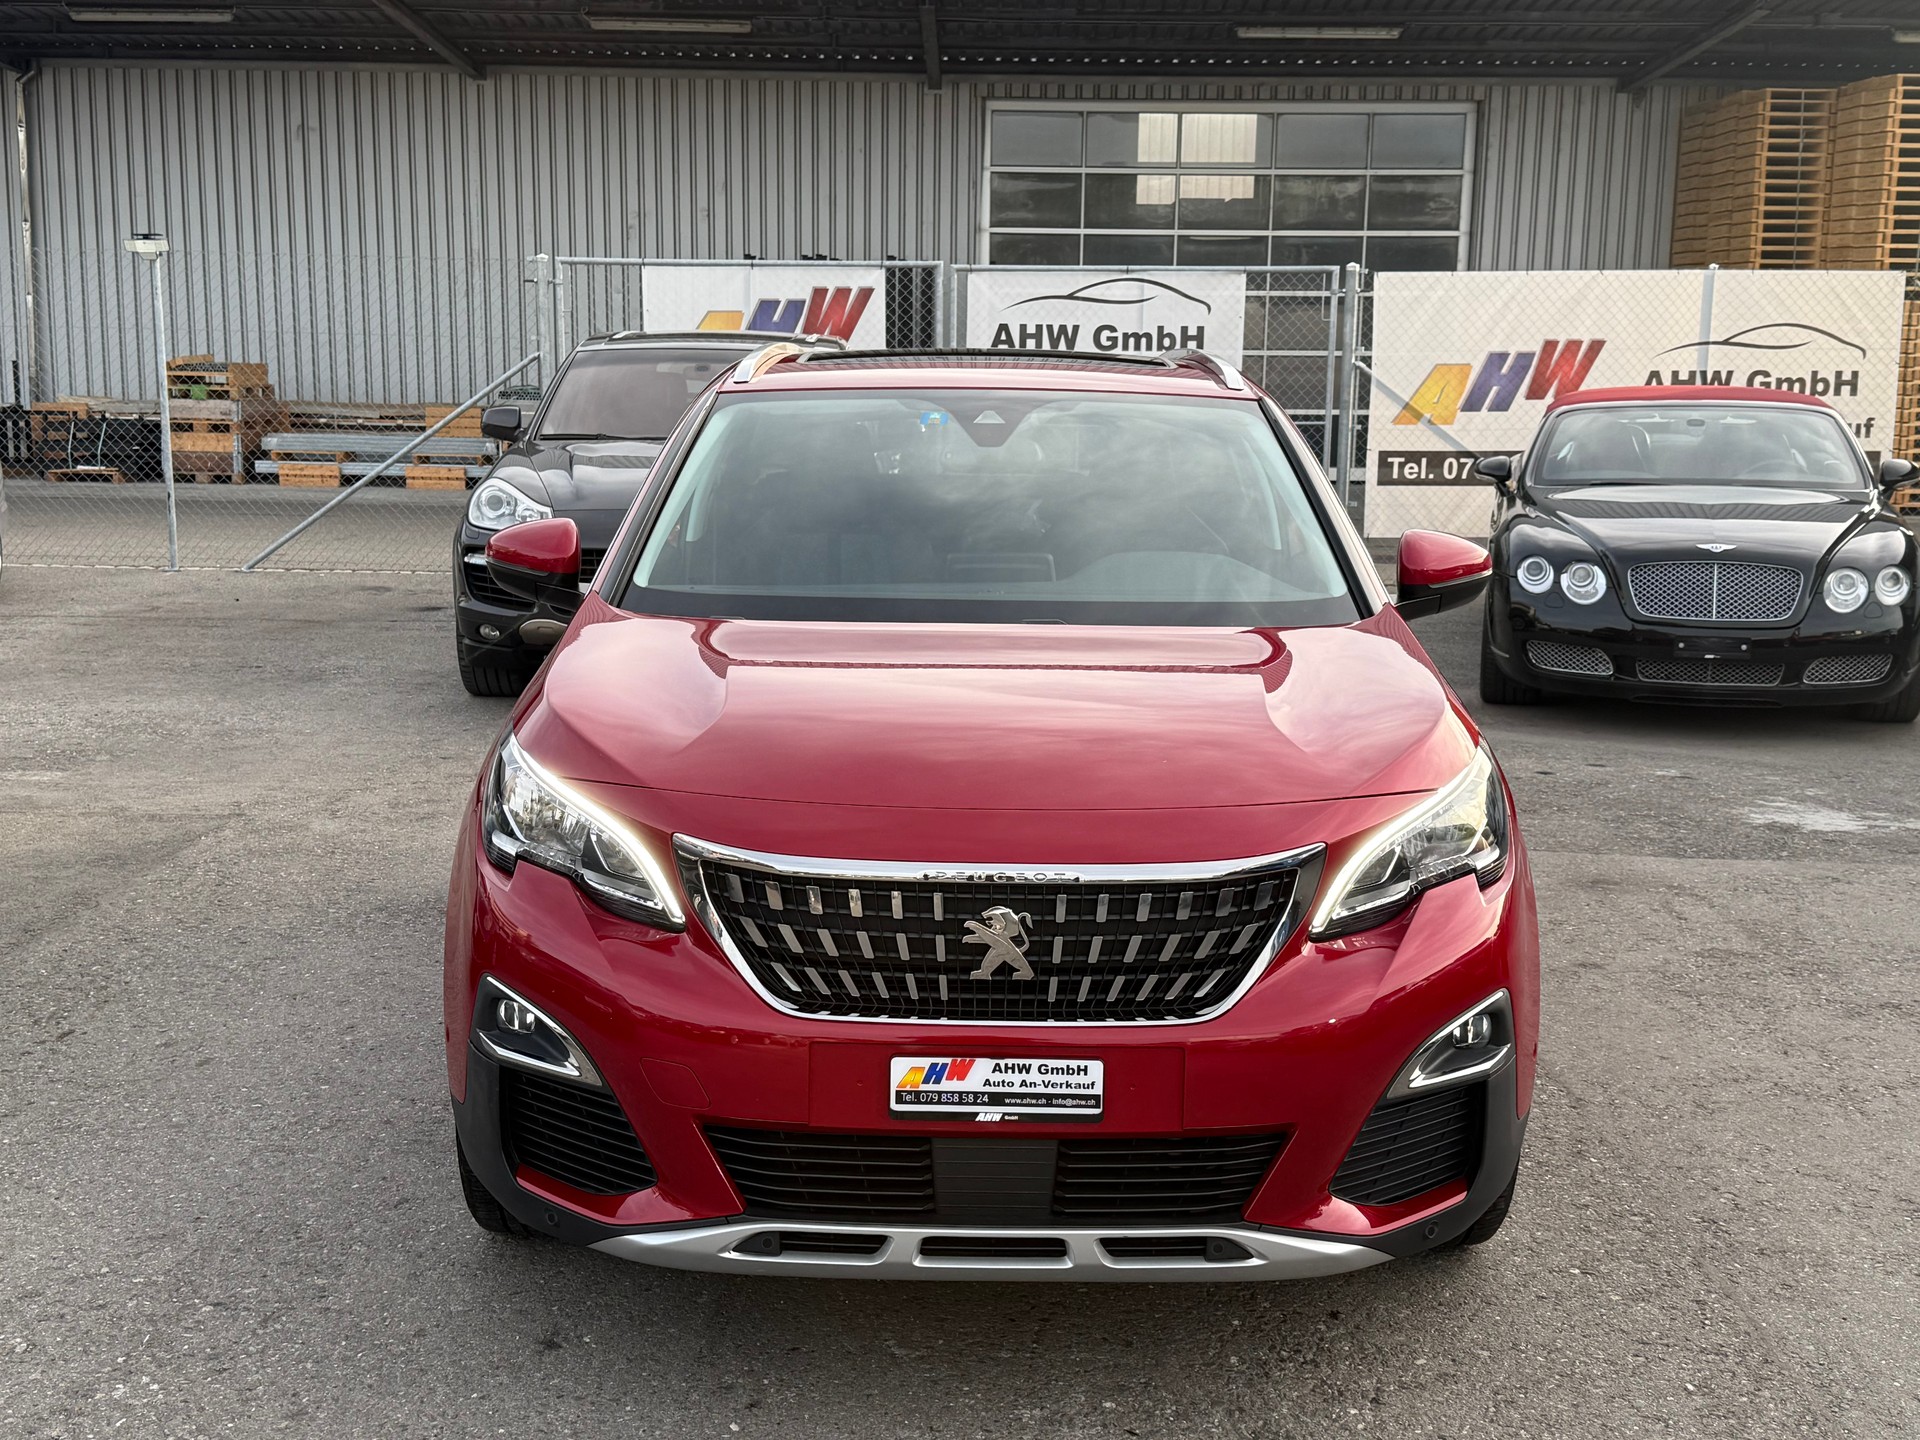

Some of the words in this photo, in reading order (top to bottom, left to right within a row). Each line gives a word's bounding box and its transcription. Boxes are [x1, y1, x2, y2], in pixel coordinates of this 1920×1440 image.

[991, 323, 1080, 350] AHW
[1093, 324, 1205, 351] GmbH
[1392, 338, 1607, 426] AHW
[1746, 370, 1860, 397] GmbH
[1387, 457, 1434, 480] Tel.
[935, 871, 1067, 883] PEUGEOT
[896, 1058, 976, 1088] AHW
[991, 1063, 1032, 1075] AHW
[1037, 1064, 1089, 1077] GmbH
[982, 1079, 1015, 1088] Auto
[1019, 1080, 1096, 1090] An-Verkauf
[900, 1092, 918, 1102] Tel.
[920, 1092, 938, 1102] 079
[941, 1093, 959, 1103] 858
[962, 1094, 974, 1103] 58
[976, 1094, 989, 1103] 24
[1004, 1097, 1047, 1105] www.ahw.ch
[1052, 1098, 1096, 1106] info@ahw.ch
[975, 1112, 1003, 1122] AHW
